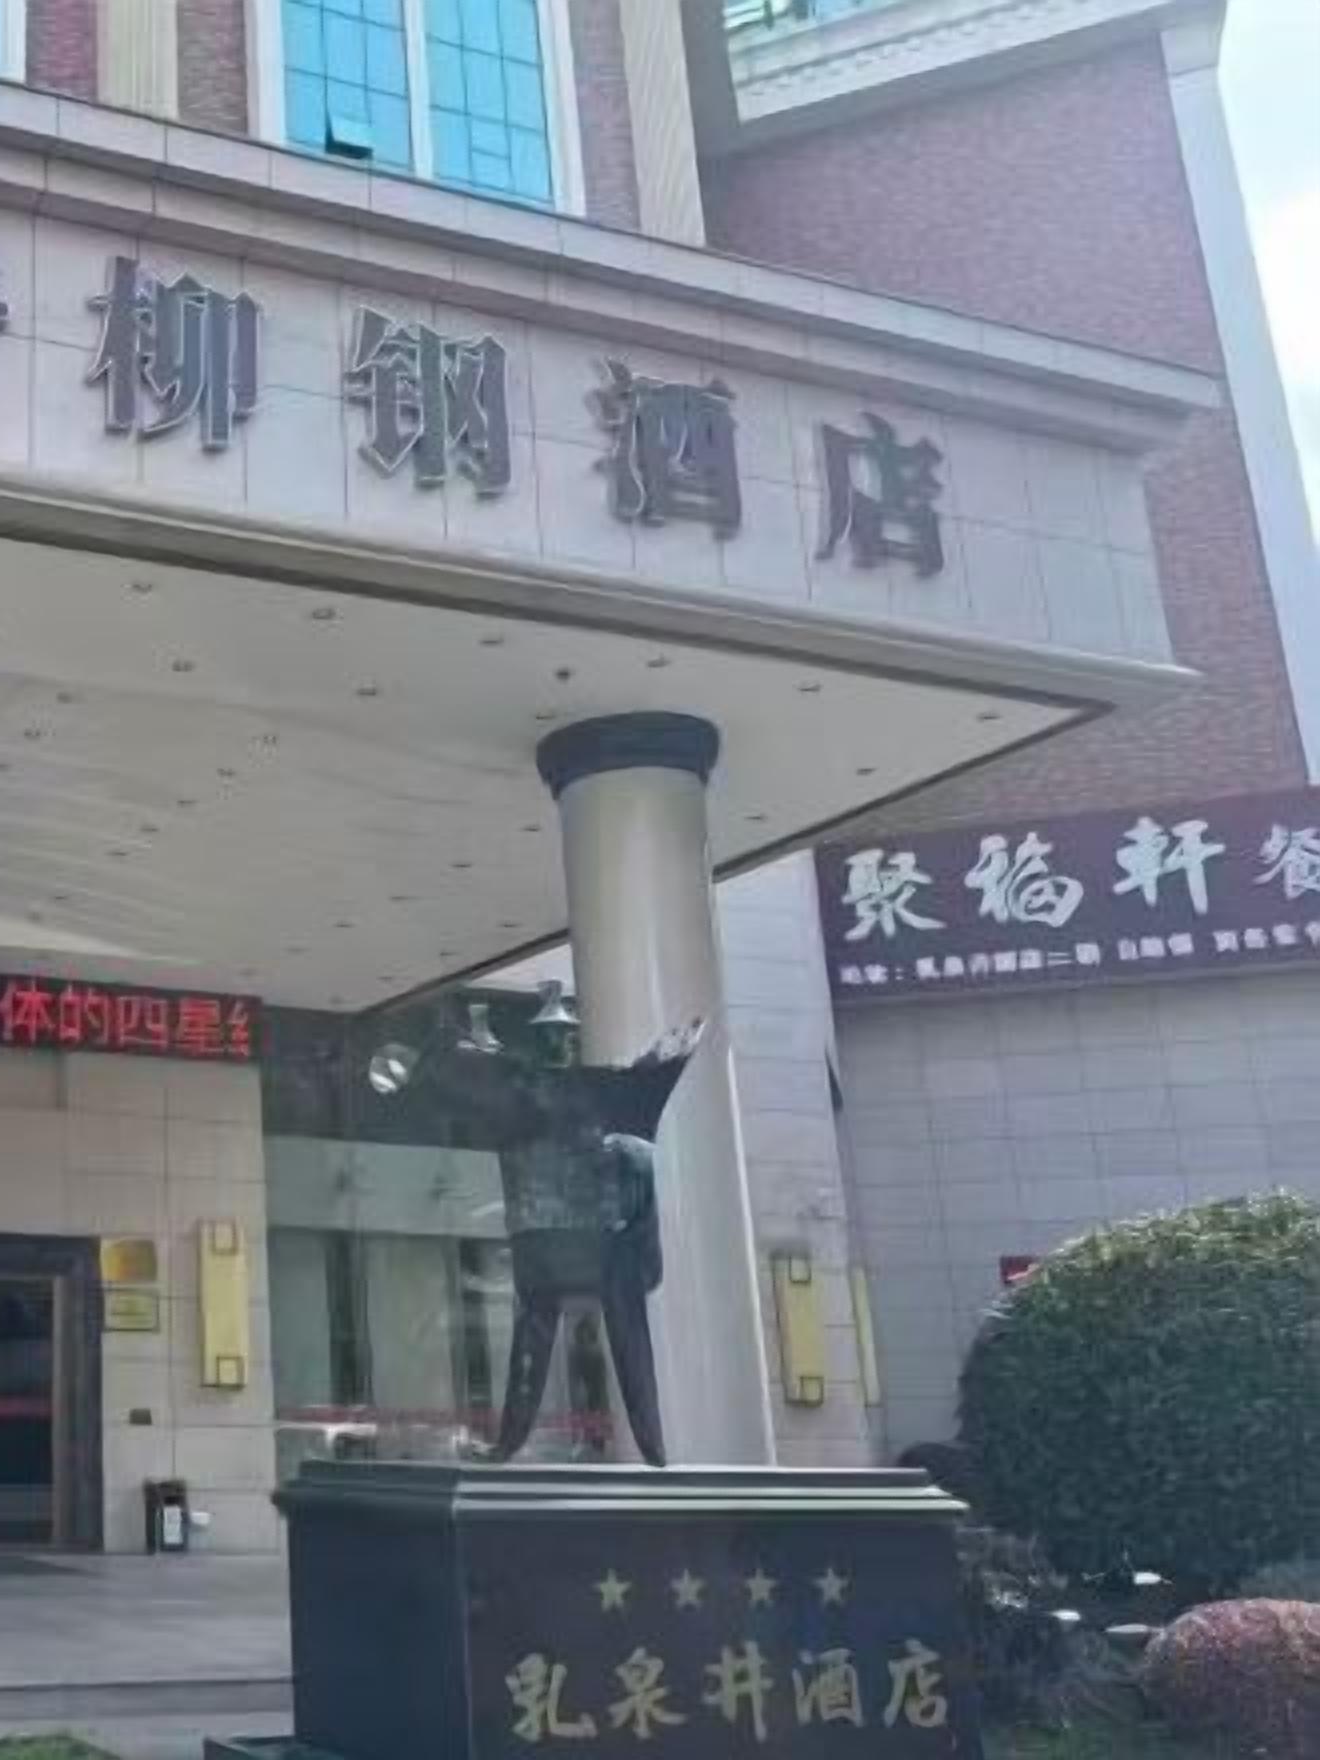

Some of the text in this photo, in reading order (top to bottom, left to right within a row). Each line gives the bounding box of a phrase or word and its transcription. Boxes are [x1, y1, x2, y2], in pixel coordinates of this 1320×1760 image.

[505, 1637, 950, 1743] 乳泉井酒店
